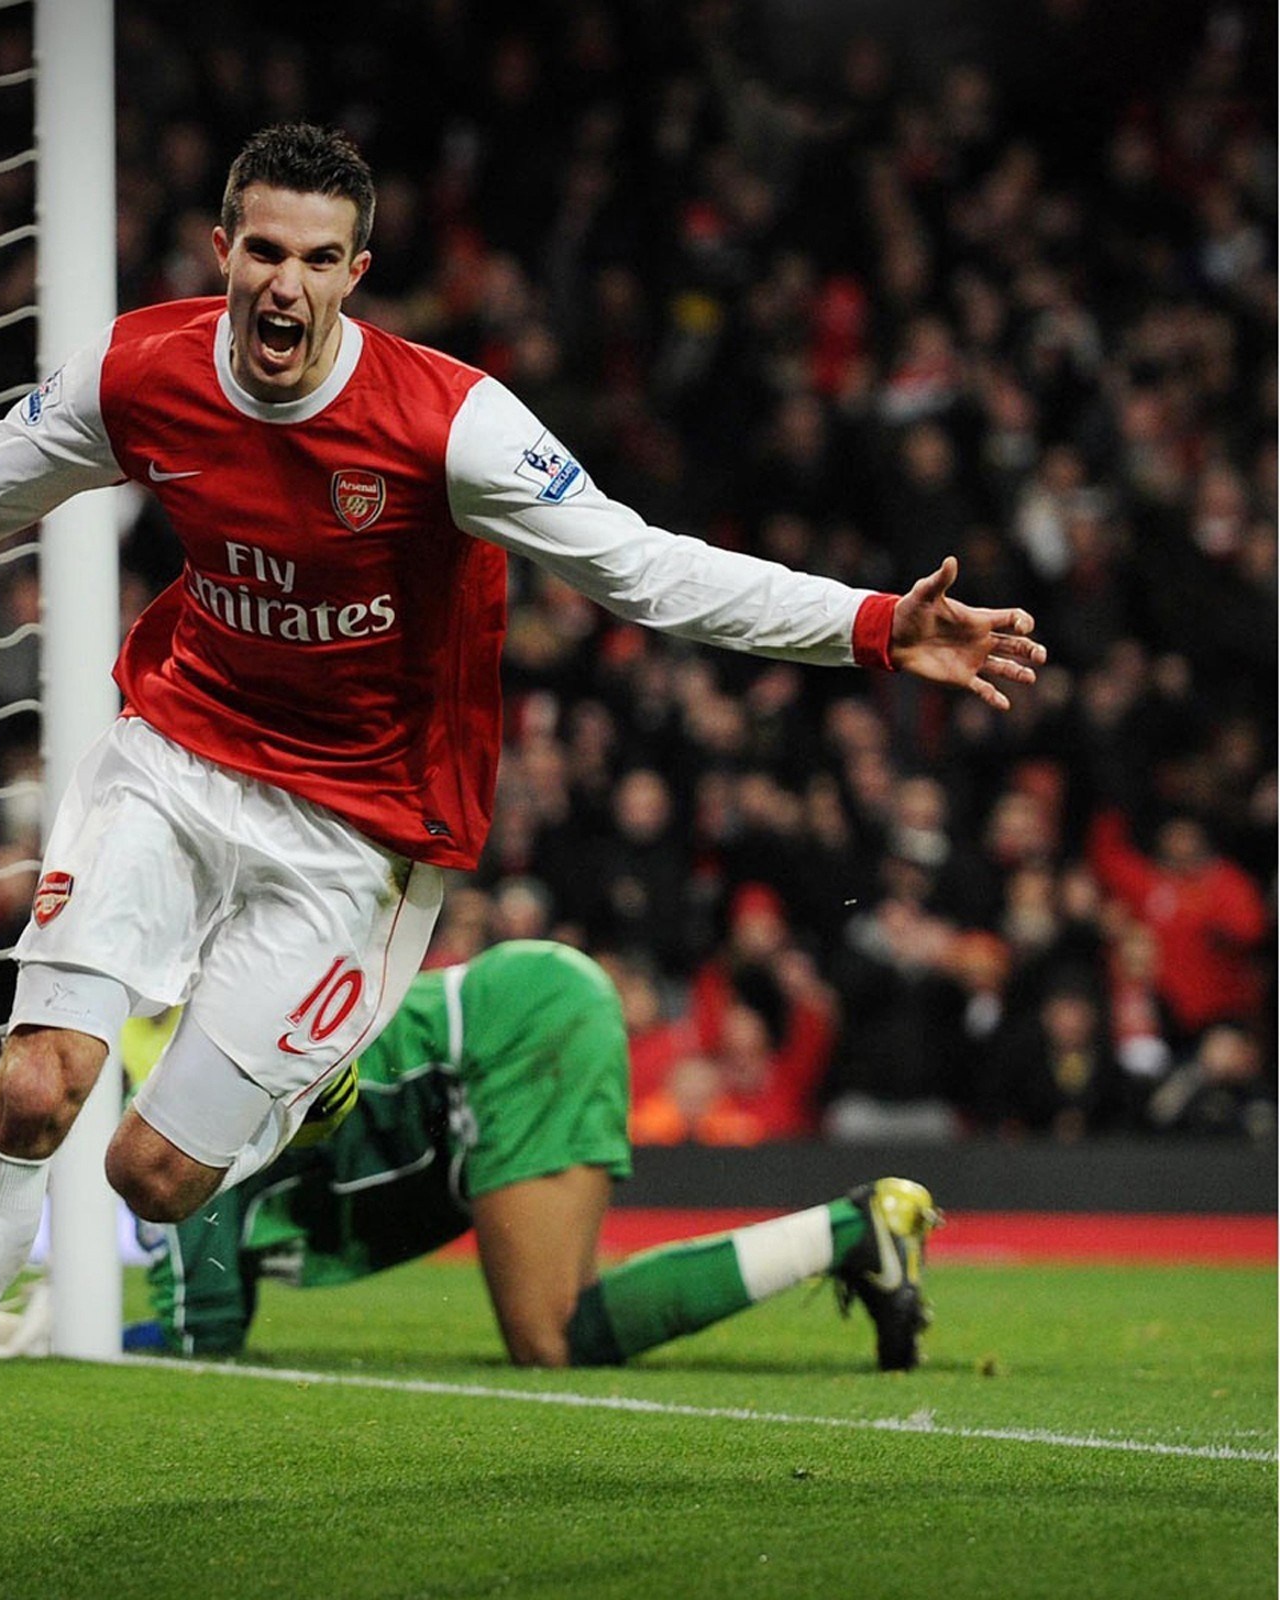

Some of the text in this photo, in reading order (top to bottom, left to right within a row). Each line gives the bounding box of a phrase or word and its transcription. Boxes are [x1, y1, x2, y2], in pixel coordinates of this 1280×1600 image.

[339, 480, 377, 493] Arsenal
[226, 541, 296, 594] Fly
[188, 570, 395, 642] mirates
[286, 955, 365, 1044] 10
